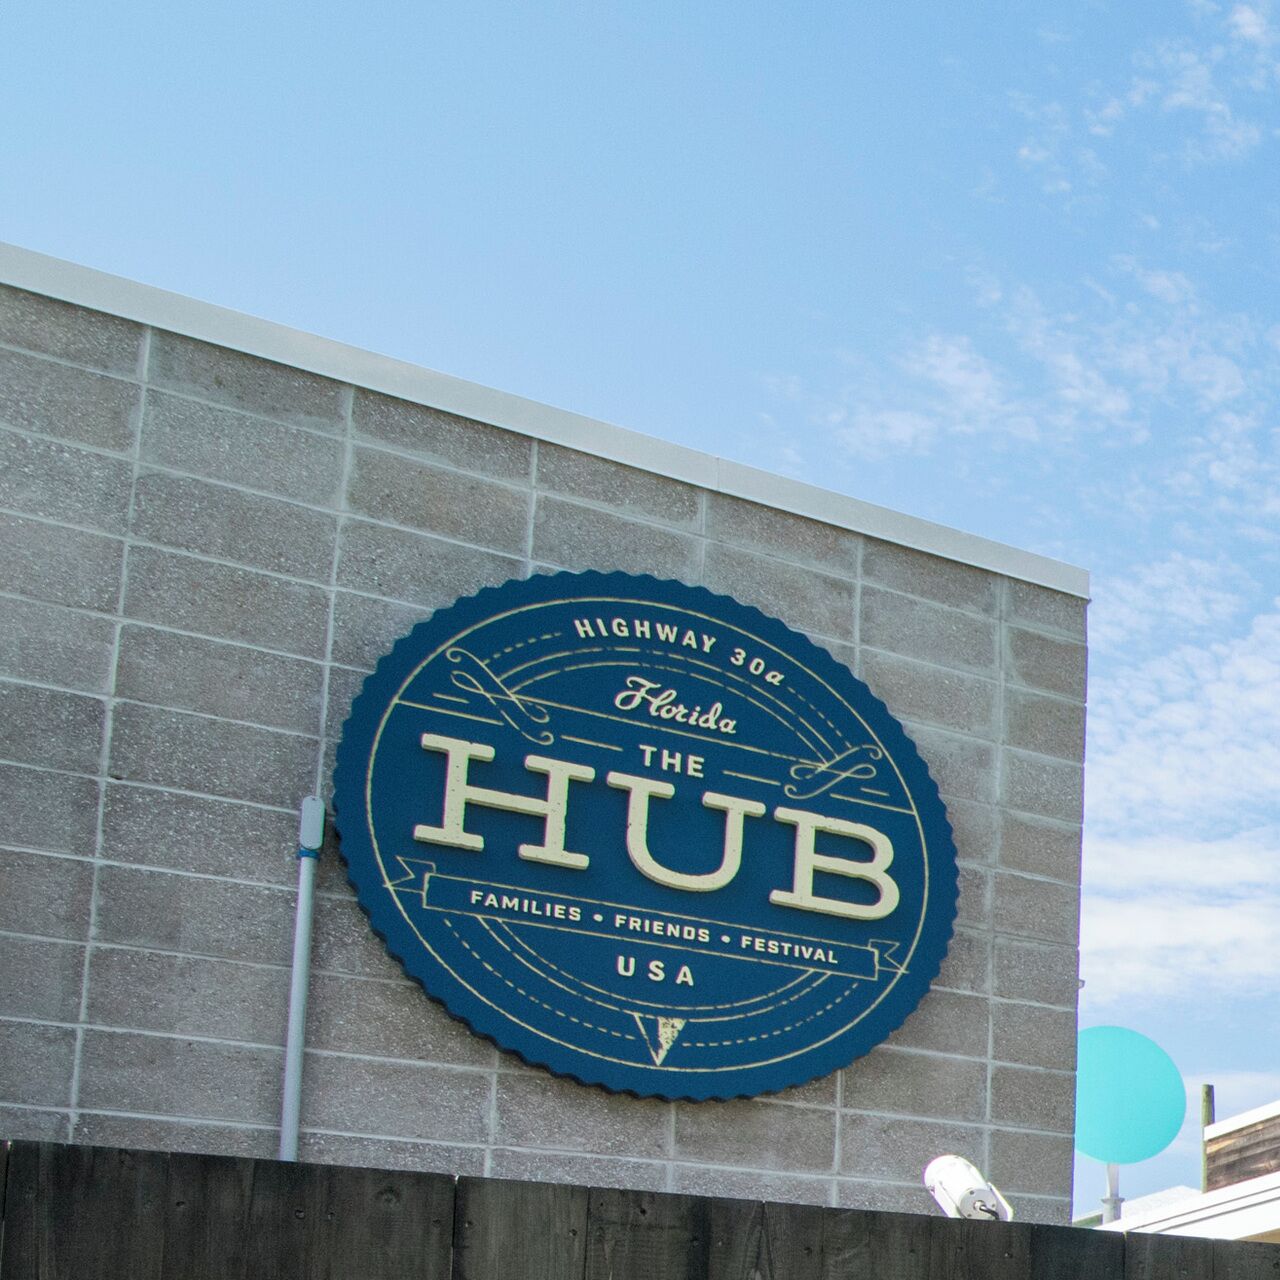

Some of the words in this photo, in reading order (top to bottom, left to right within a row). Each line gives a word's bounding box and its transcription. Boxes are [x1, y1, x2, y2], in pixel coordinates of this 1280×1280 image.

[574, 618, 716, 653] HIGHWAY
[731, 648, 785, 686] 30a
[614, 676, 737, 734] Florida
[639, 744, 705, 778] THE
[414, 733, 901, 921] HUB
[471, 890, 582, 921] FAMILIES
[615, 914, 710, 943] FRIENDS
[741, 935, 838, 964] FESTIVAL
[617, 955, 695, 987] USA
